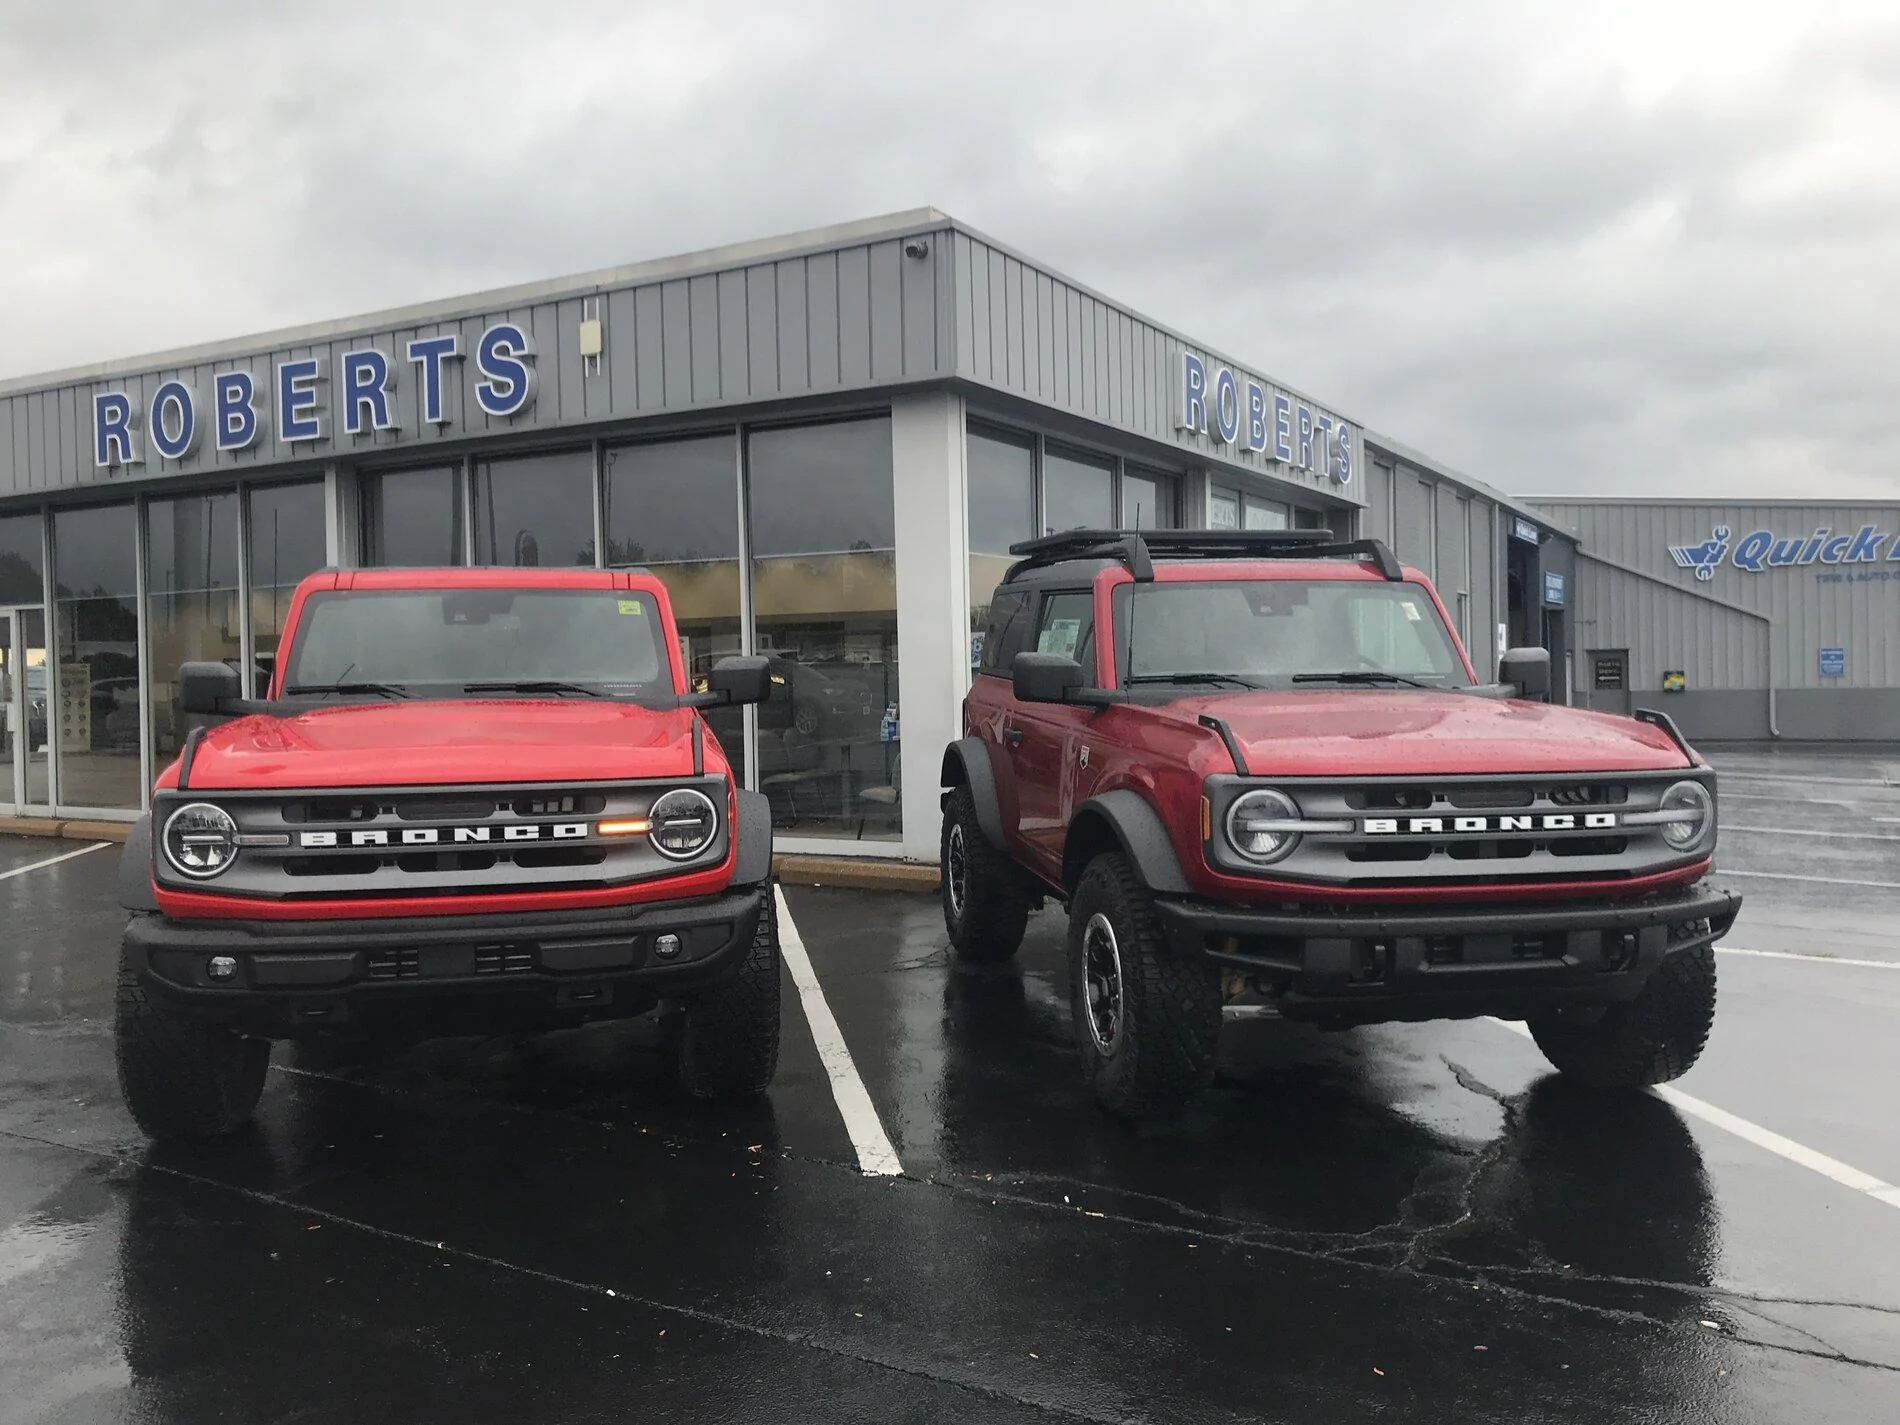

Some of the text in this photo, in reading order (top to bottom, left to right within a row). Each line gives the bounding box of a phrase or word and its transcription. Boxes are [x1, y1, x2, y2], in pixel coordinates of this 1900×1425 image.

[93, 323, 534, 467] ROBERTS
[1180, 351, 1352, 484] ROBERTS
[1732, 525, 1889, 572] Quick
[300, 823, 588, 848] BRONCO
[1363, 813, 1616, 834] BRONCO
